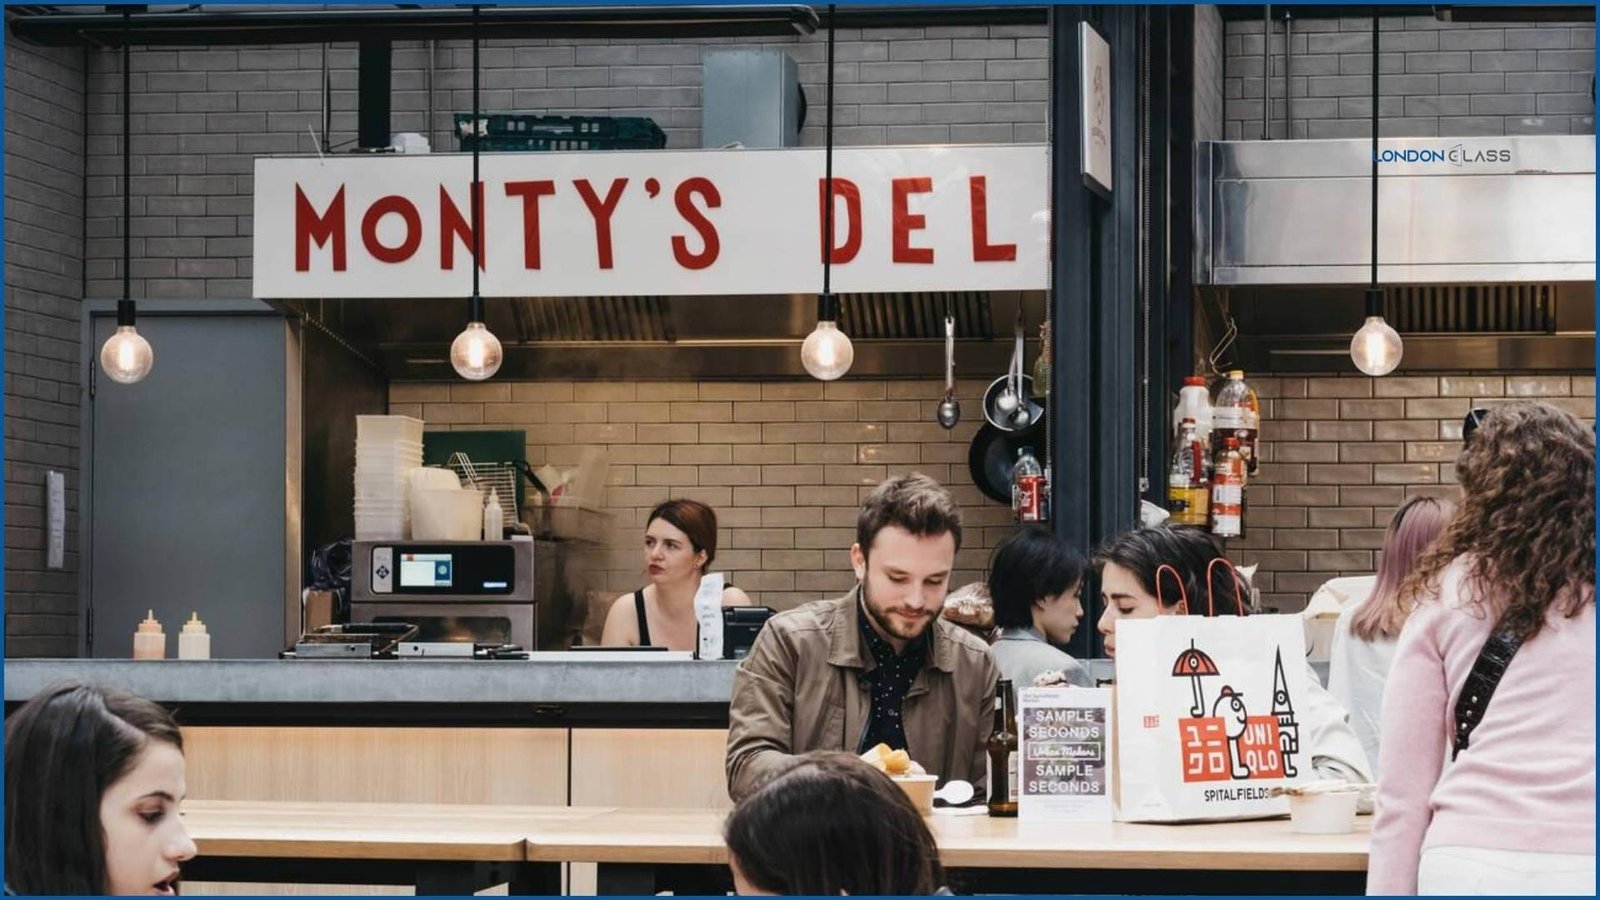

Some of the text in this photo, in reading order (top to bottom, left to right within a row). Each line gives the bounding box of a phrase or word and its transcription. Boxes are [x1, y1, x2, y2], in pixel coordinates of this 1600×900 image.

[295, 175, 1052, 273] MONTY'S DEL
[1036, 710, 1094, 722] SAMPLE
[1028, 726, 1100, 739] SECONDS
[1244, 723, 1273, 746] UNI
[1246, 749, 1278, 775] QLO
[1036, 764, 1094, 776] SAMPLE
[1028, 780, 1100, 793] SECONDS
